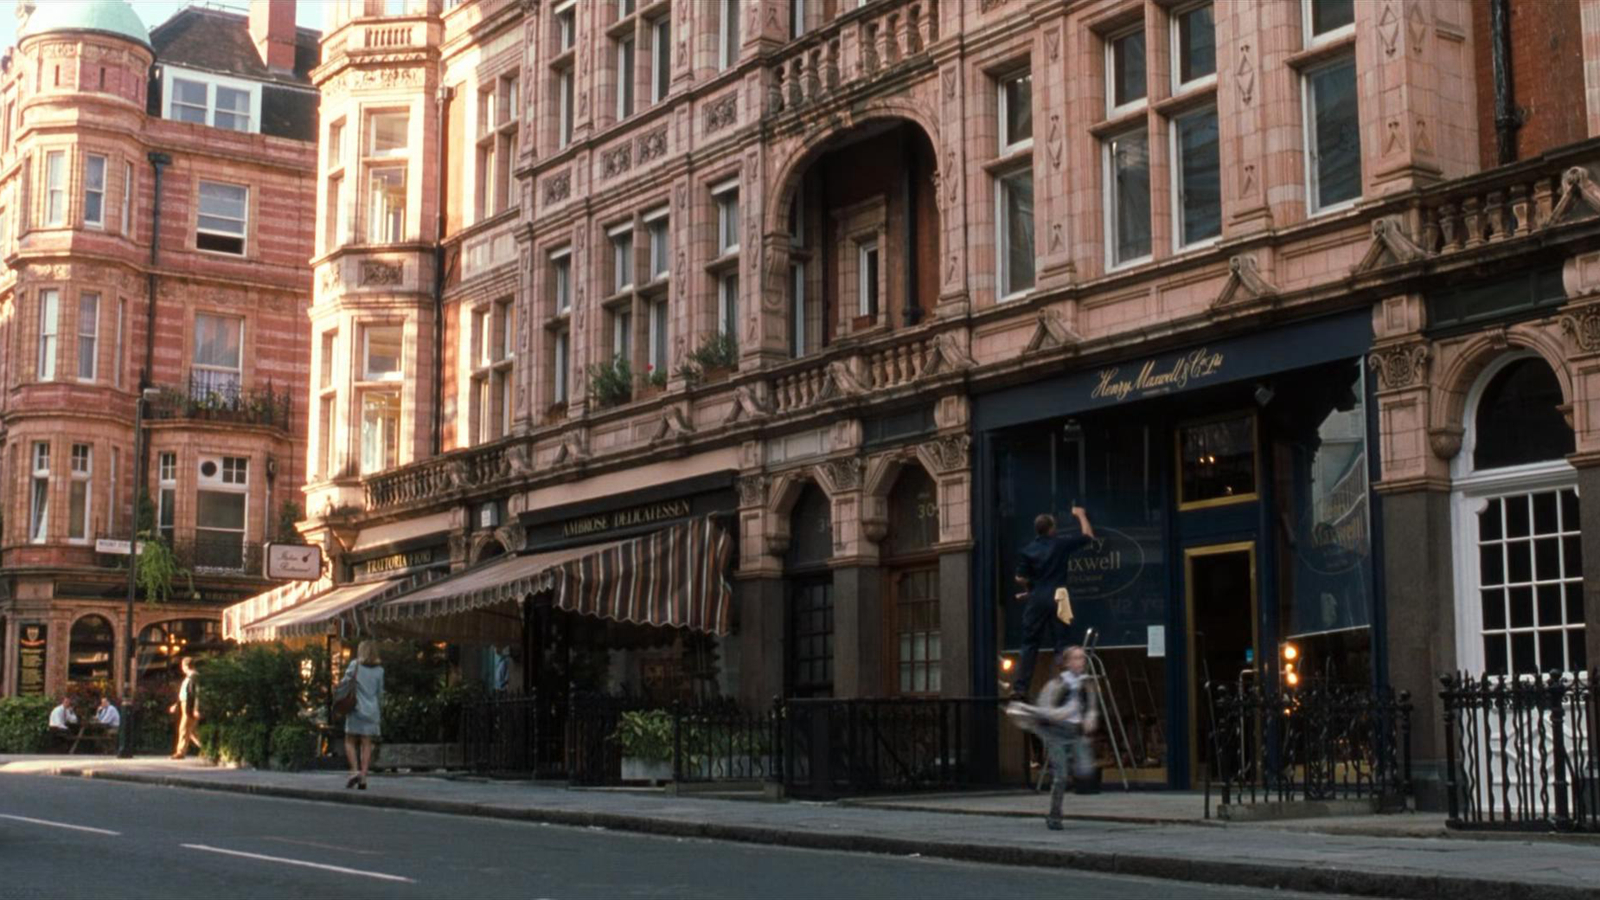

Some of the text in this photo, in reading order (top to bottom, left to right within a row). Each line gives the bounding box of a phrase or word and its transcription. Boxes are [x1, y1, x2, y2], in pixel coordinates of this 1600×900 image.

[1091, 368, 1132, 399] Henry
[1133, 359, 1185, 388] Maxwell
[563, 500, 690, 537] AMBROSE DELICATESSEN
[366, 553, 408, 574] TRATTORIA
[1067, 551, 1121, 571] xwell
